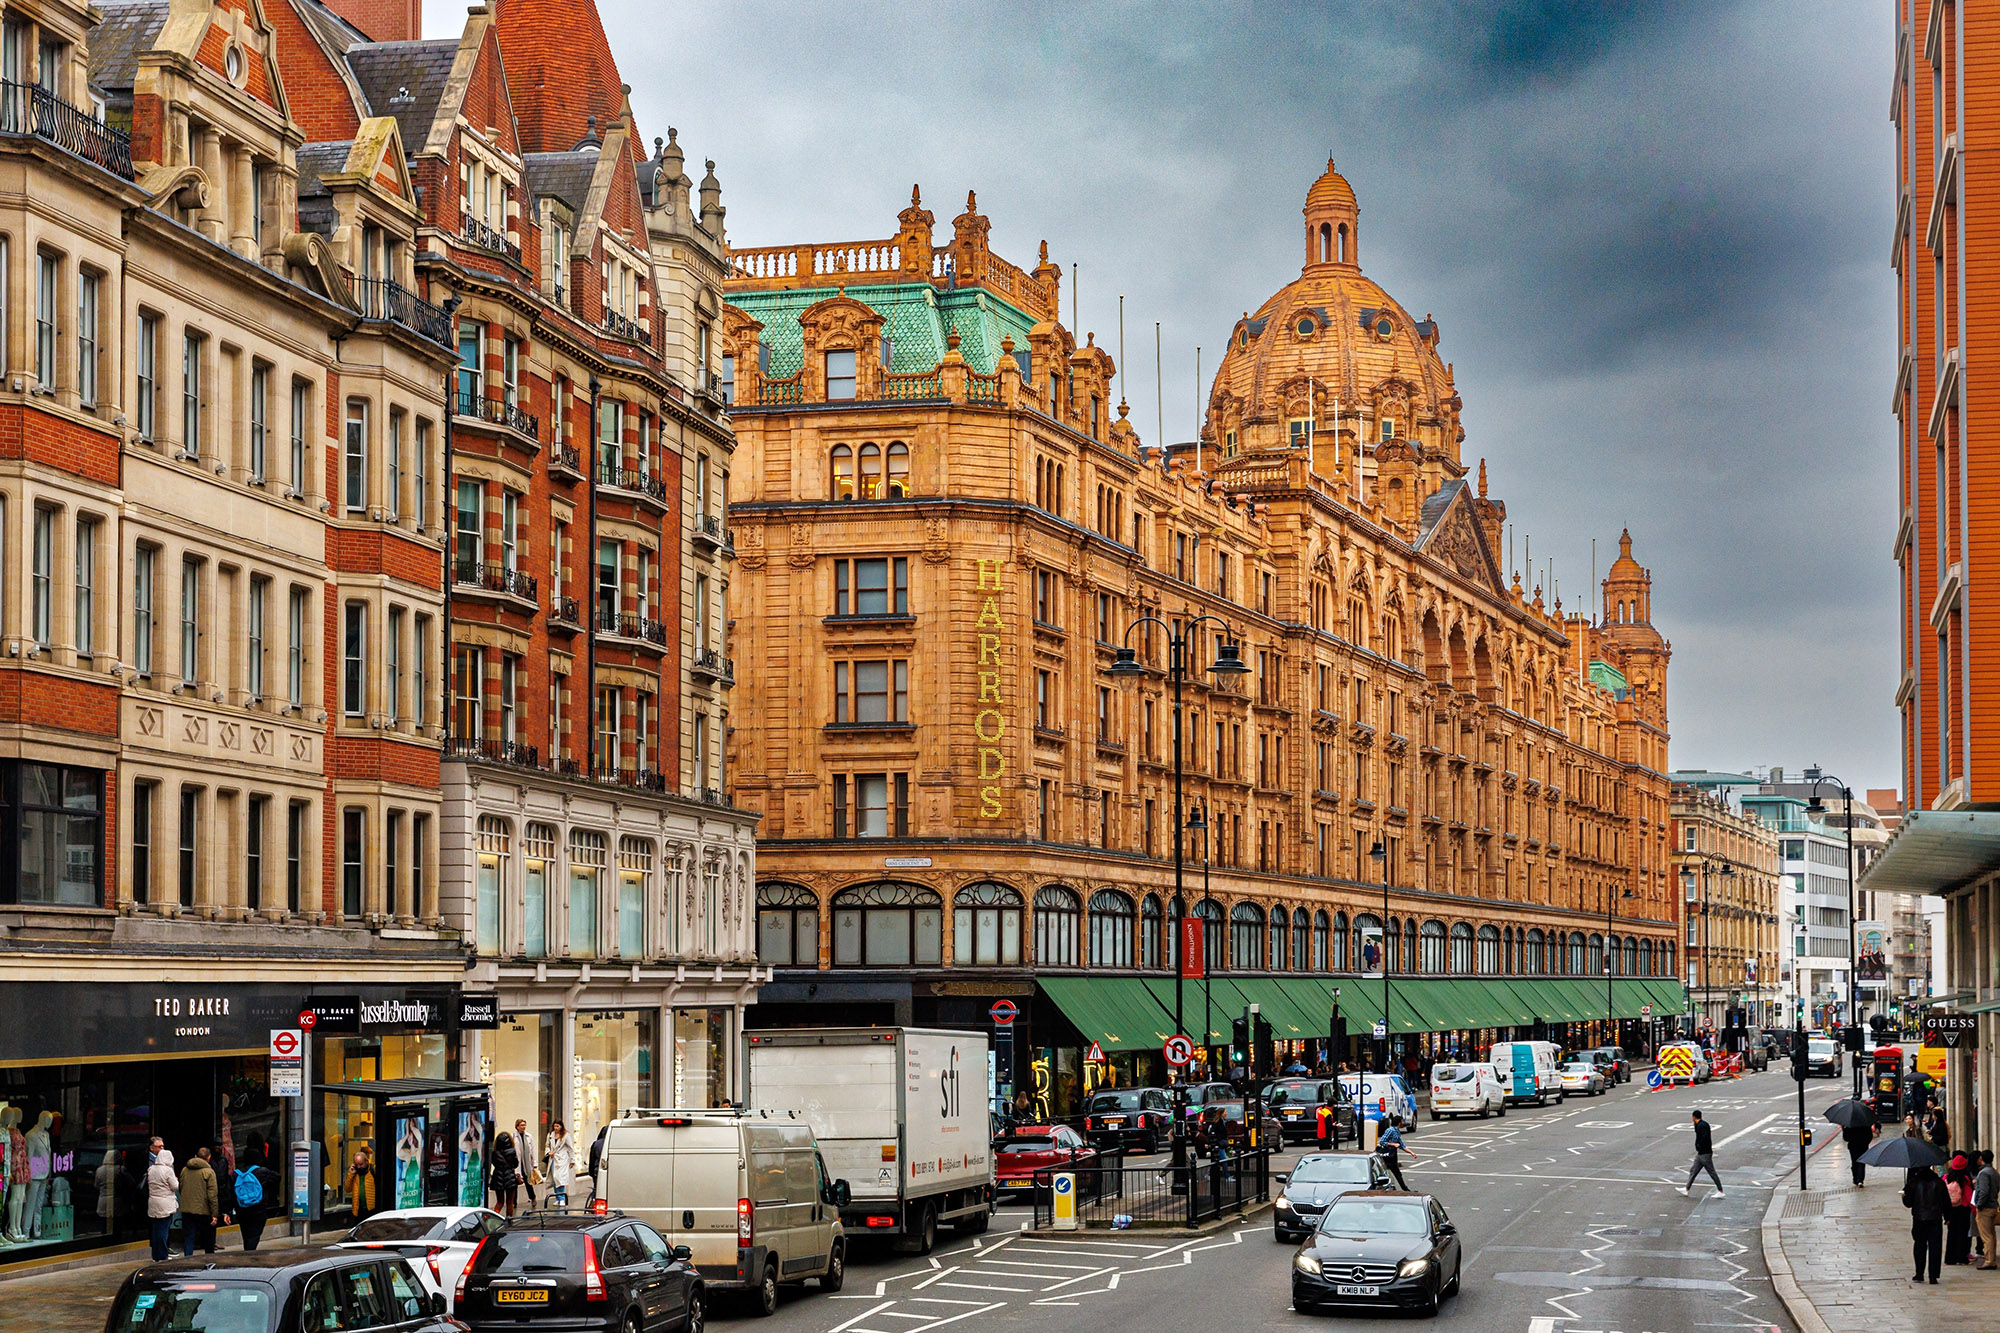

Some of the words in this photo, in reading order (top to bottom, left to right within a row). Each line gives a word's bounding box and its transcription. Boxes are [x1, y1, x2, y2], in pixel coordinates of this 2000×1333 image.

[975, 558, 1006, 818] HARRODS
[155, 998, 180, 1016] TED
[188, 998, 230, 1016] BAKER
[464, 1004, 491, 1014] Russell
[300, 1015, 313, 1025] KC
[1927, 1018, 1975, 1028] GUESS
[175, 1027, 210, 1036] LONDON
[941, 1045, 960, 1119] sfi
[1341, 1286, 1358, 1295] KM18
[1360, 1287, 1375, 1295] NLP
[501, 1291, 525, 1301] EY60
[527, 1291, 545, 1301] JCZ
